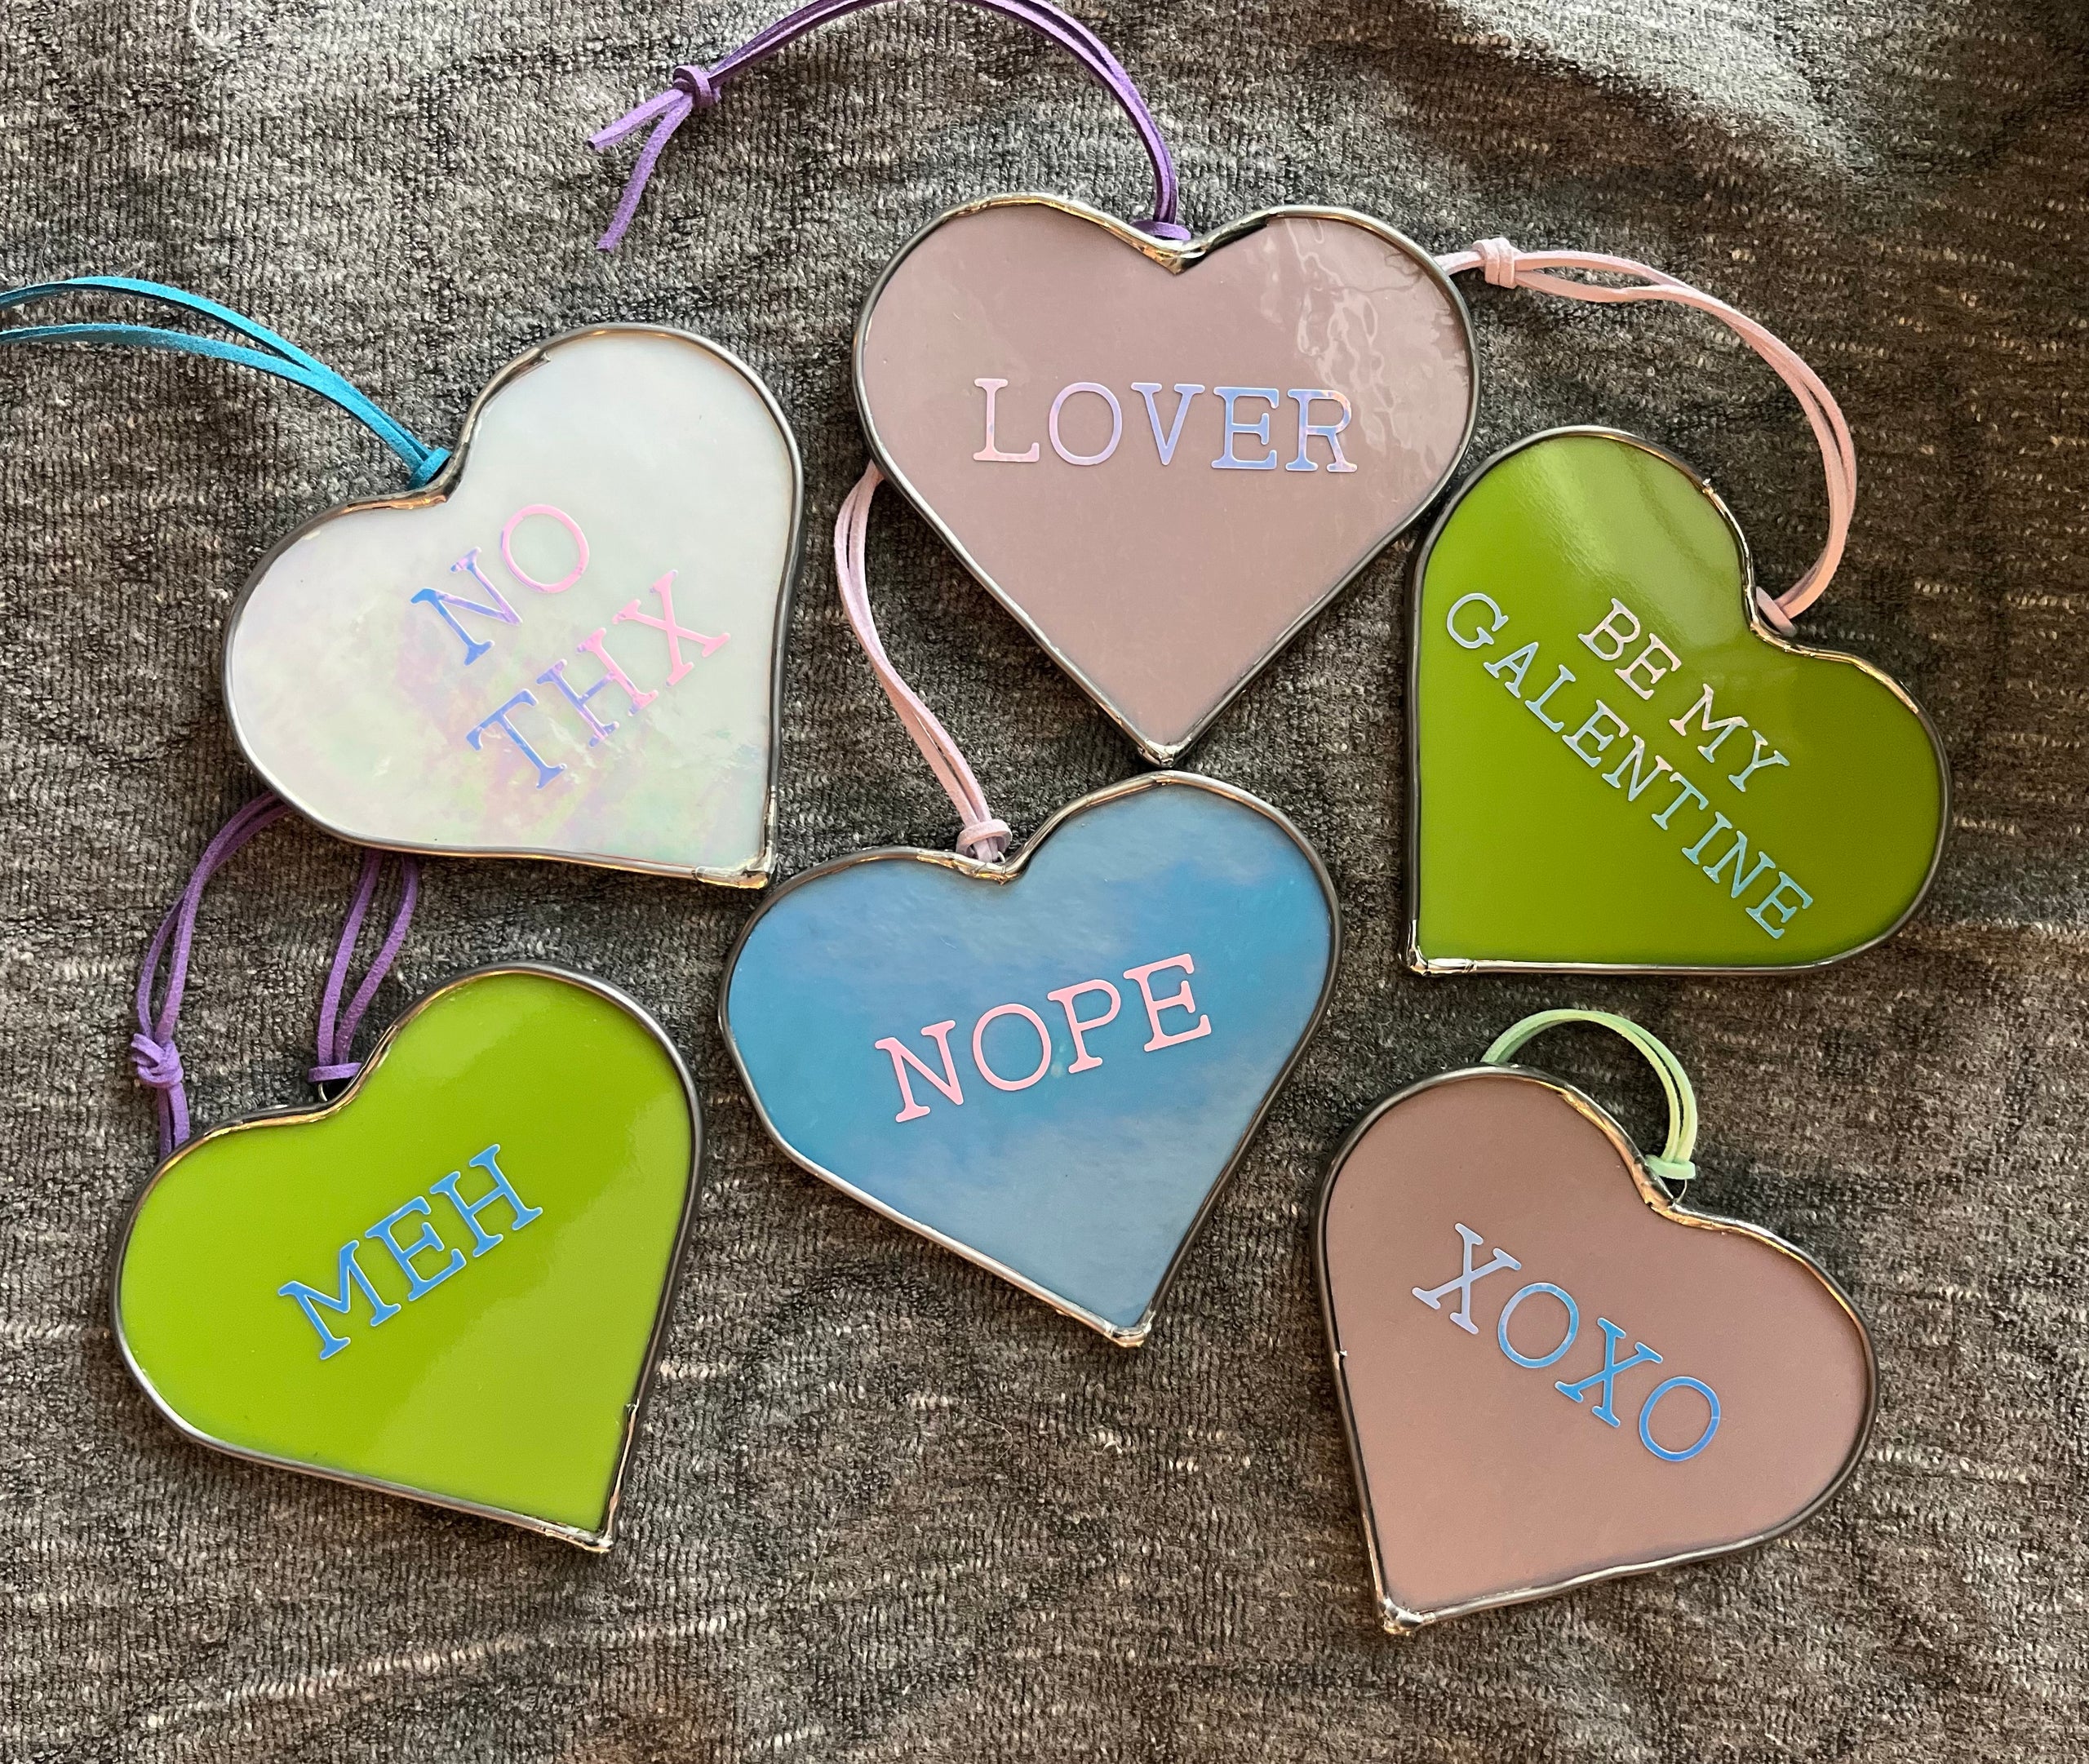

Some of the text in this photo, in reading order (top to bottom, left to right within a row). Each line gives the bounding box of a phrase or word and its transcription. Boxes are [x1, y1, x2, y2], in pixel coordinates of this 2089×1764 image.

[973, 378, 1358, 472] LOVER
[410, 504, 589, 666] NO
[465, 570, 730, 790] THX
[1446, 592, 1813, 939] GALENTINE
[1577, 598, 1790, 791] BE MY
[875, 953, 1212, 1123] NOPE
[278, 1144, 543, 1360] MEH
[1412, 1223, 1721, 1461] XOXO
